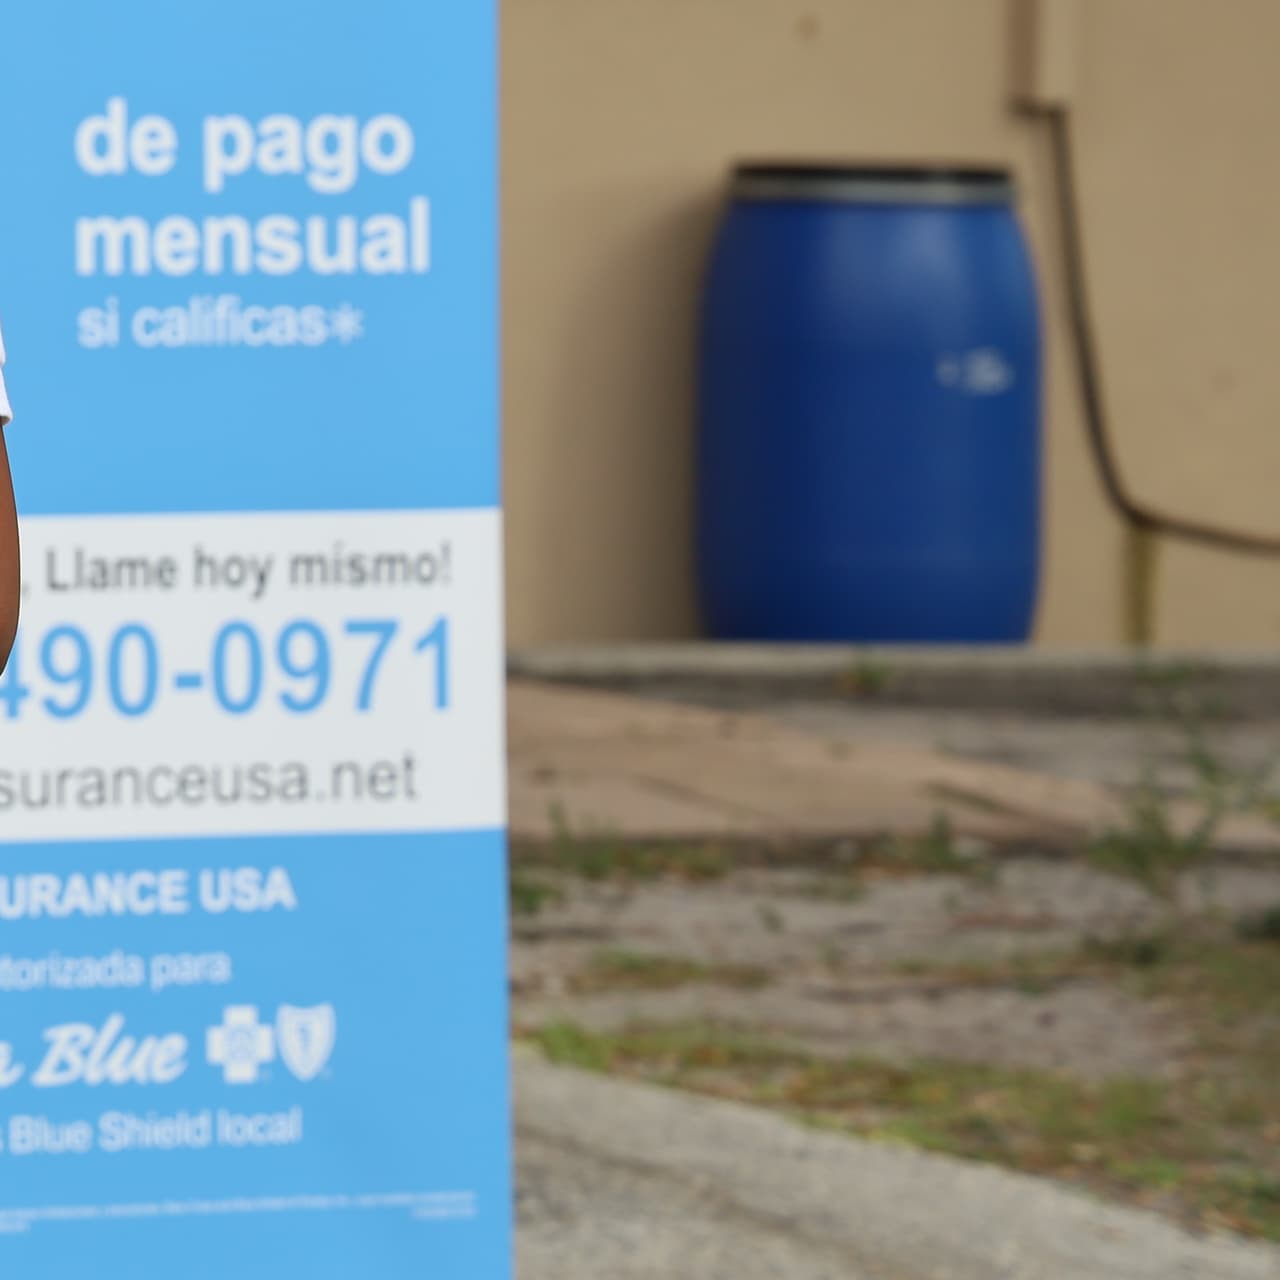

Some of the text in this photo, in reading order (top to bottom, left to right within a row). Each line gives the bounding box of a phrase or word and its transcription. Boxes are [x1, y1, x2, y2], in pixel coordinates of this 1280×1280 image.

[74, 97, 414, 195] de pago
[75, 195, 431, 277] mensual
[77, 296, 120, 349] si
[45, 542, 454, 601] Llame hoy mismo!
[198, 866, 298, 913] USA
[151, 951, 233, 992] para
[31, 1013, 189, 1088] Blue
[8, 1114, 93, 1155] Blue
[98, 1108, 213, 1152] Shield
[218, 1105, 303, 1147] local
